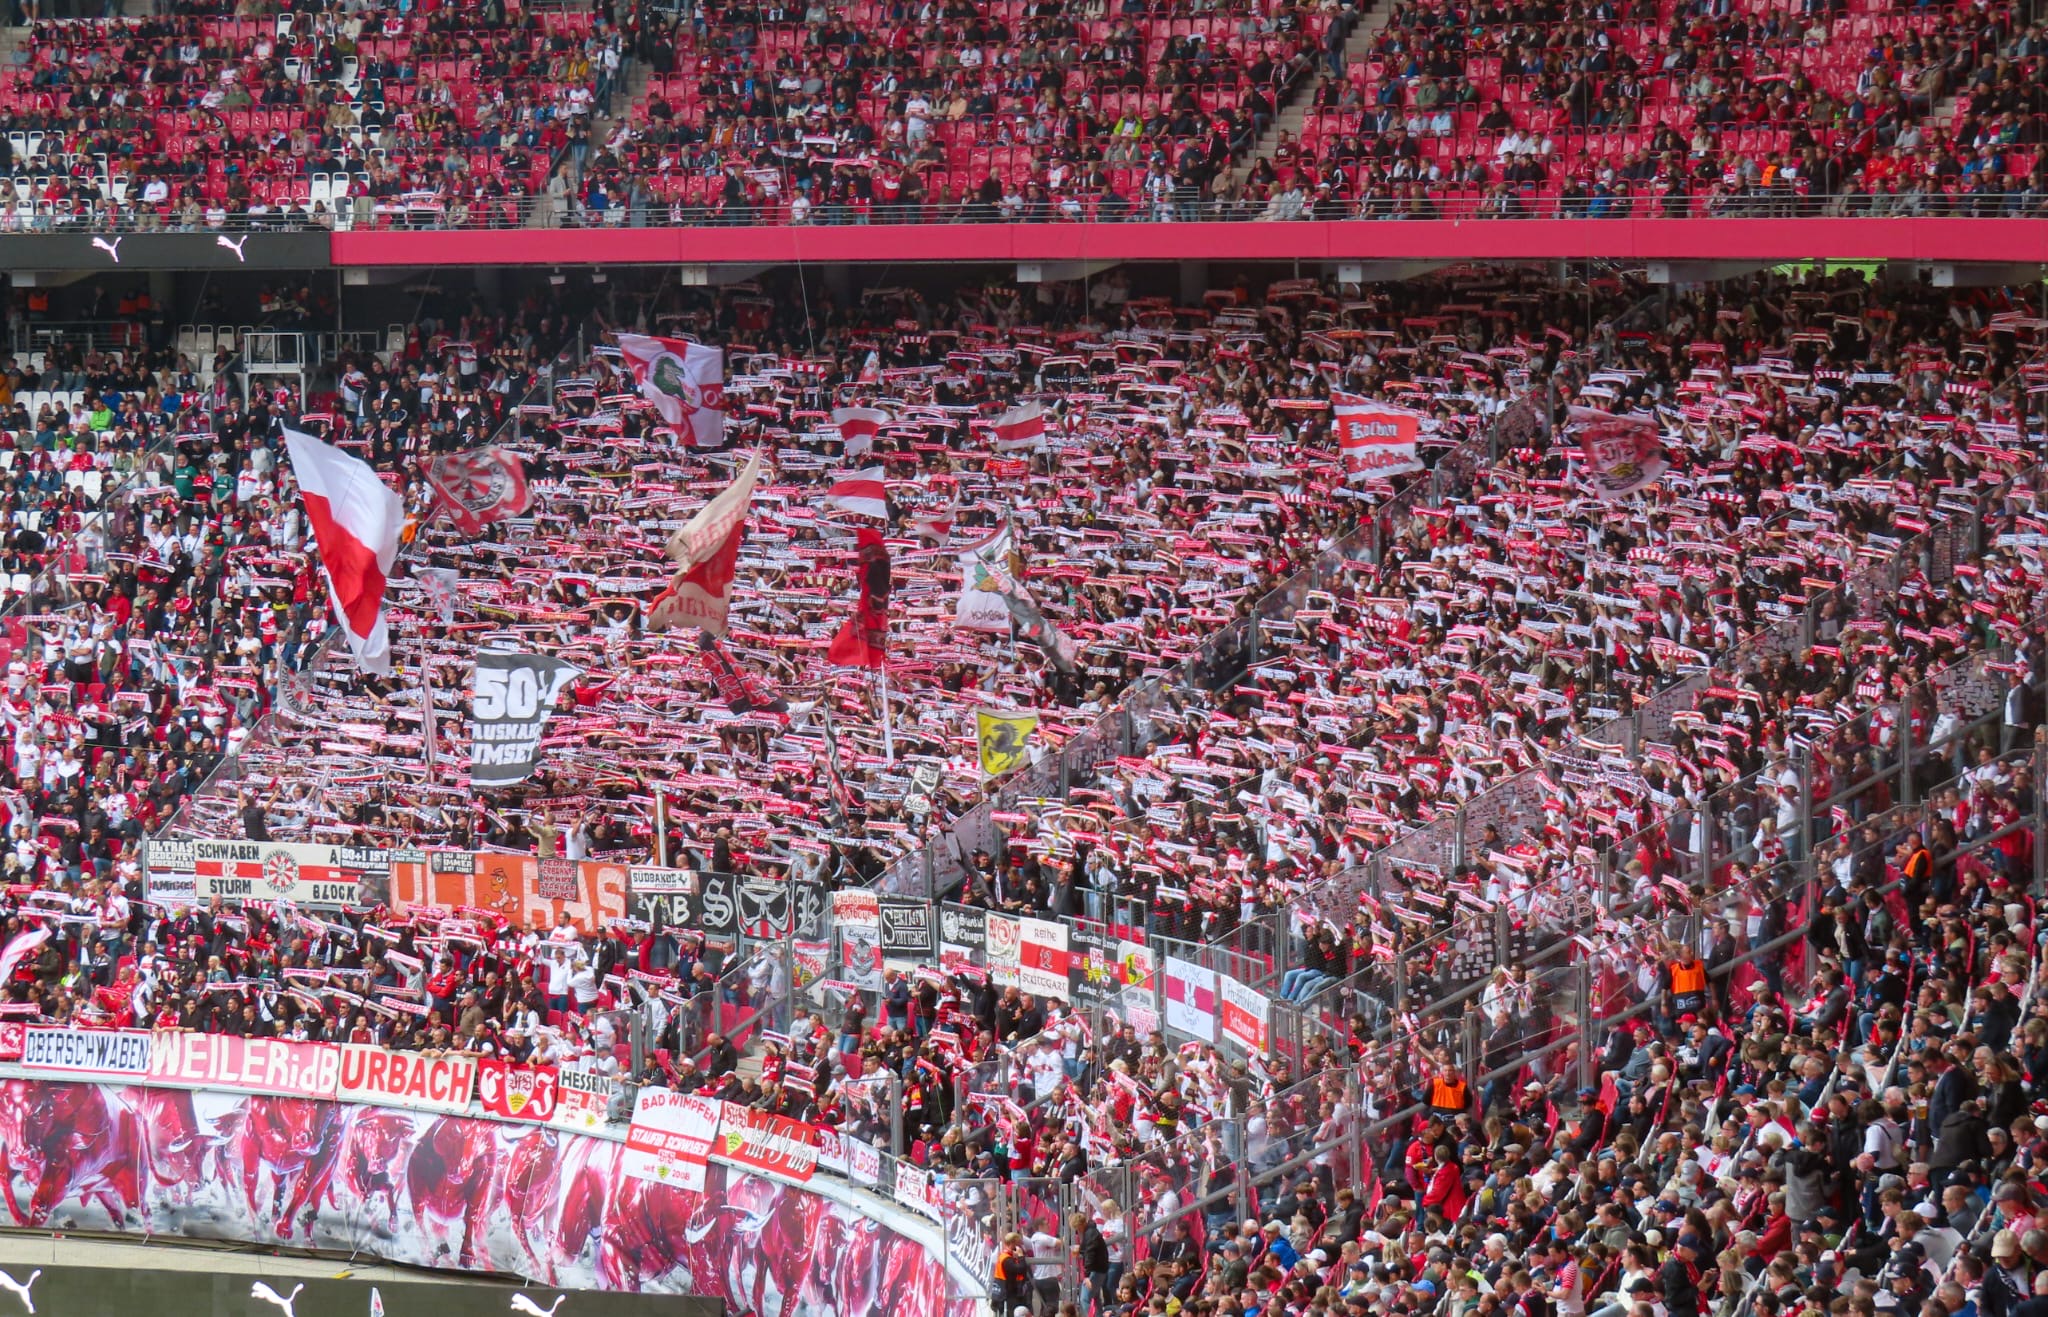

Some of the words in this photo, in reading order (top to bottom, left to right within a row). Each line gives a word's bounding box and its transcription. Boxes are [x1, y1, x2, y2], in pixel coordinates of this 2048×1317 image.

[149, 840, 194, 853] ULTRAS
[197, 843, 260, 860] SCHWABEN
[369, 850, 389, 862] IST
[442, 859, 473, 867] IMMER
[222, 862, 238, 876] 02
[210, 879, 252, 895] STURM
[313, 884, 356, 902] BLOCK
[26, 1031, 149, 1070] OBERSCHWABEN
[341, 1049, 473, 1105] URBACH
[561, 1070, 610, 1095] HESSEN
[641, 1095, 666, 1111] BAD
[668, 1094, 717, 1127] WIMPFEN
[820, 1135, 842, 1160] BAD
